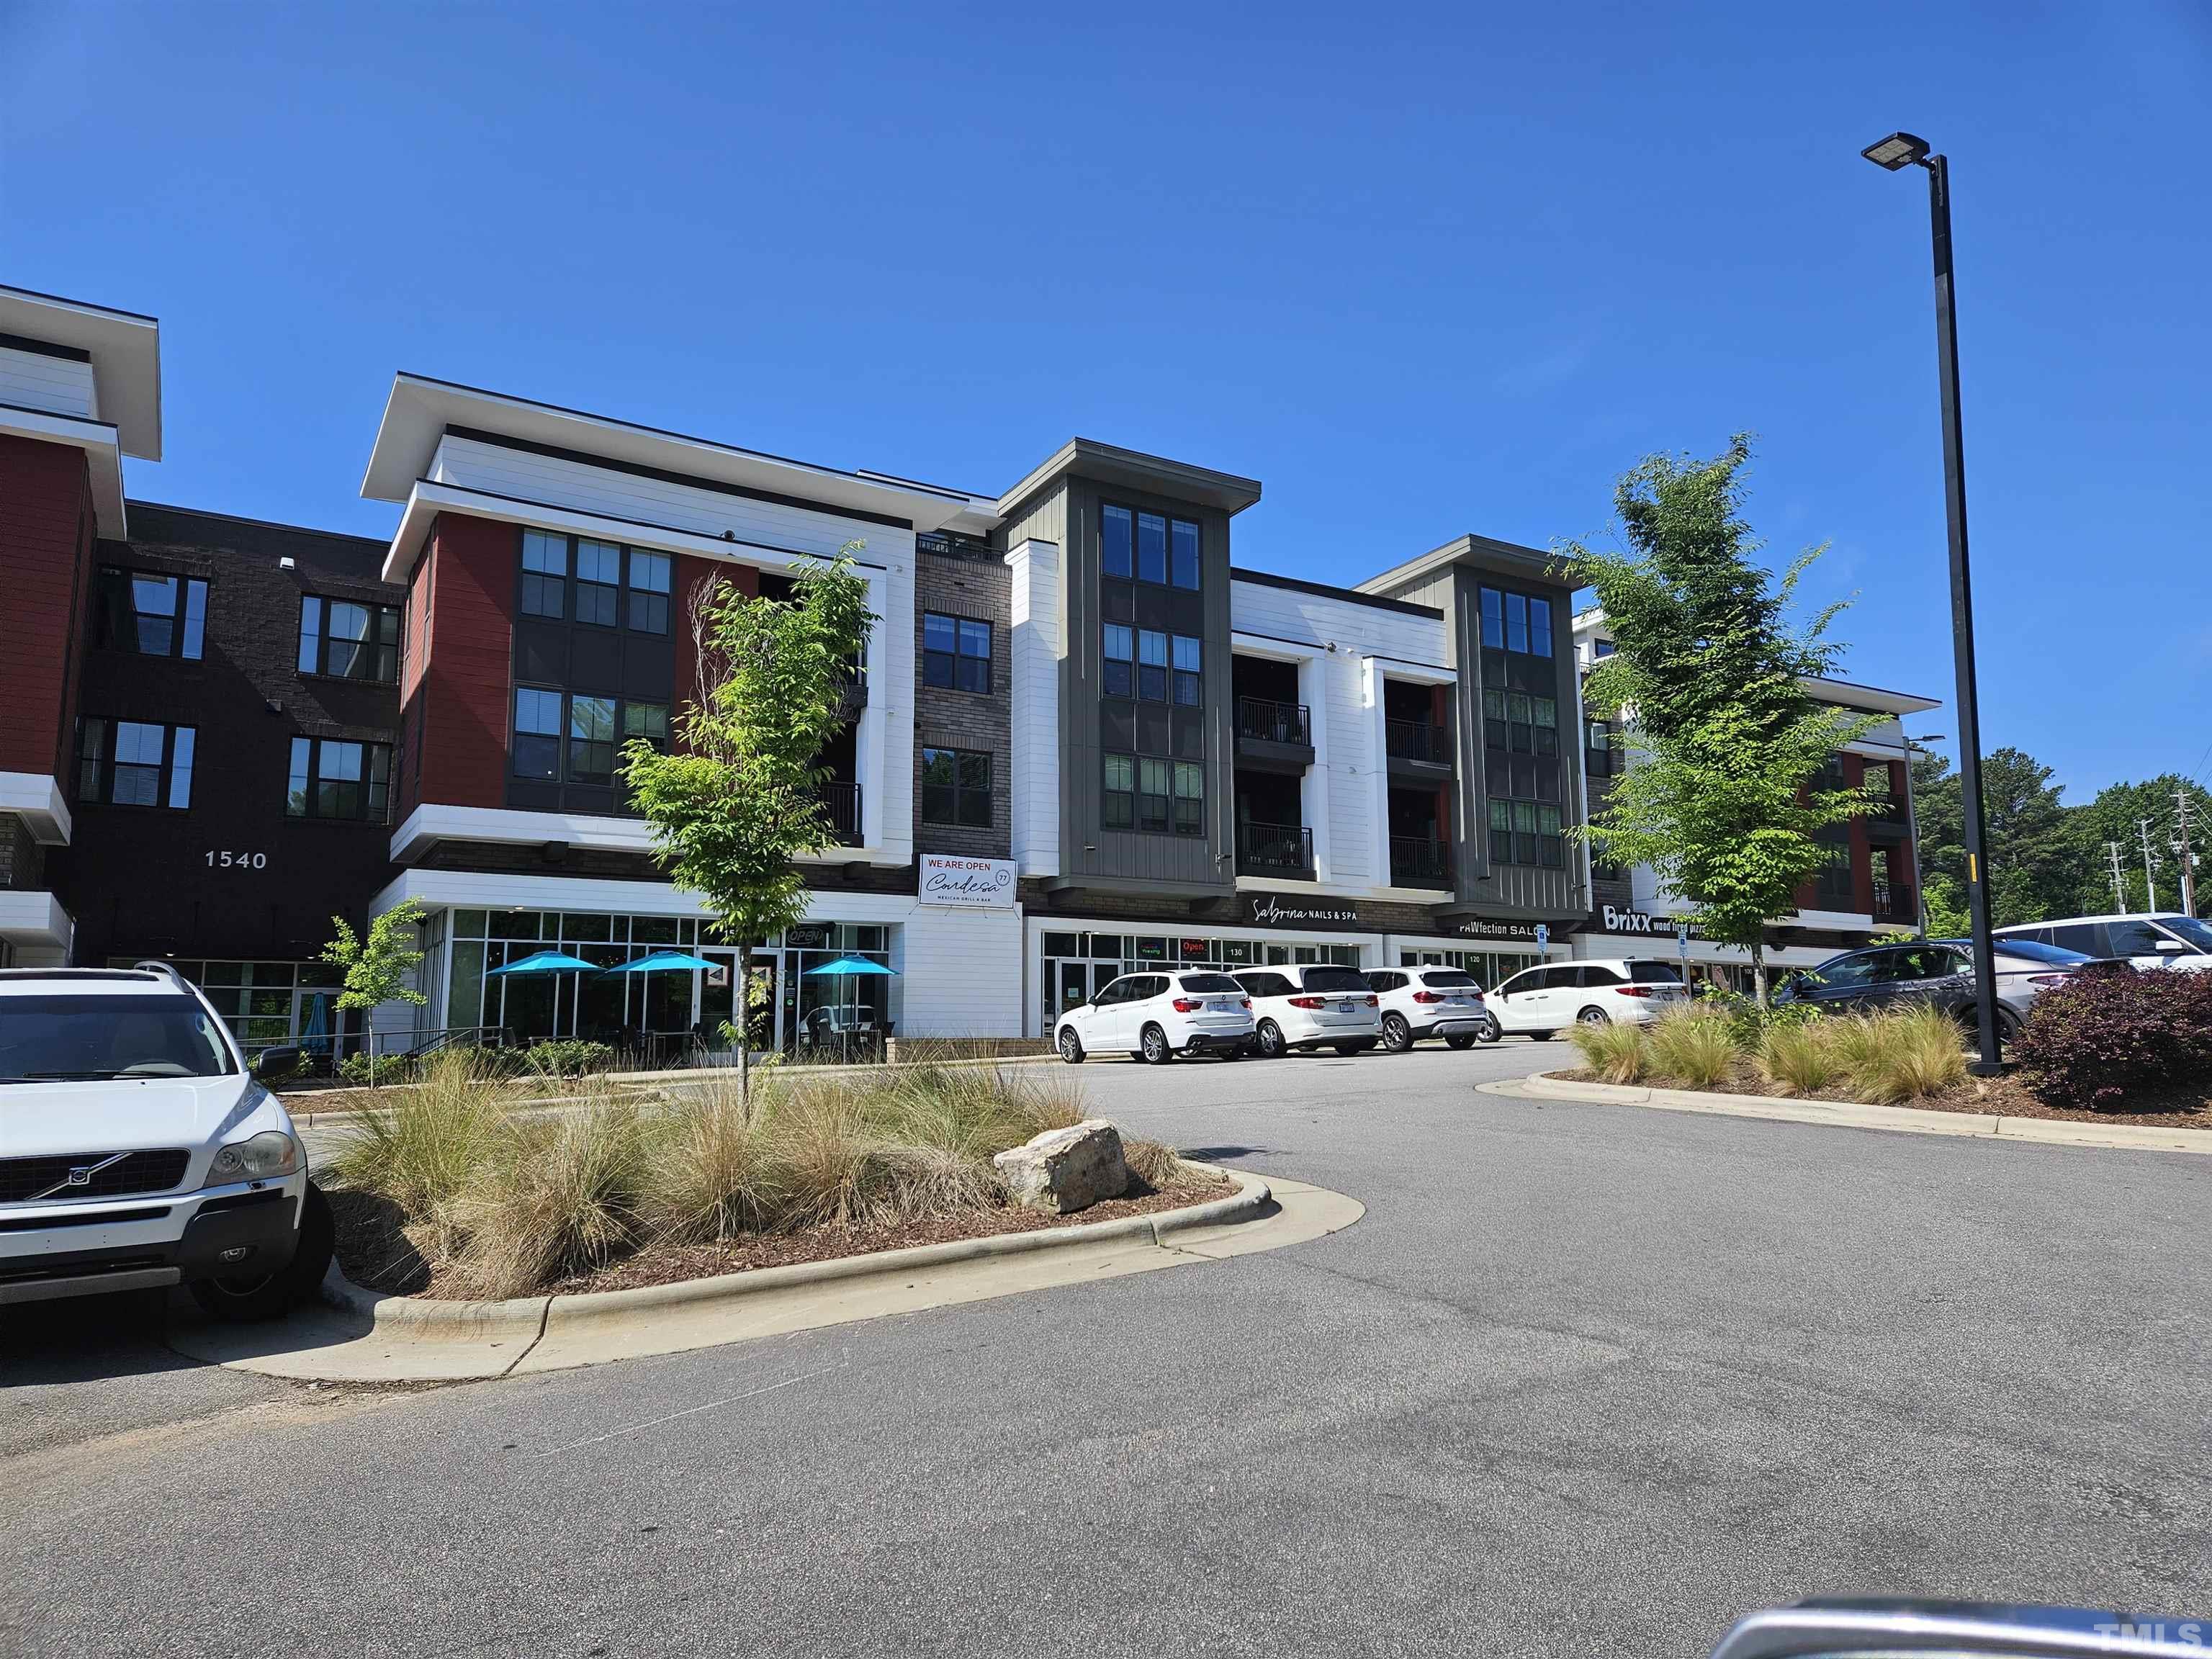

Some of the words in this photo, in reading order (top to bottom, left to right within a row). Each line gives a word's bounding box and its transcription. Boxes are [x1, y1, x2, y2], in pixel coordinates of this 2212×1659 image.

[205, 850, 266, 869] 1540
[928, 859, 943, 868] WE
[945, 860, 963, 869] ARE
[966, 862, 991, 871] OPEN
[926, 873, 1001, 894] Condesa
[1253, 896, 1308, 923] Sabrina
[1308, 910, 1332, 920] NAILS
[1334, 911, 1340, 920] &
[1341, 912, 1357, 921] SPA
[1603, 904, 1652, 932] Brixx
[1653, 922, 1671, 931] wood
[1672, 922, 1689, 932] fired
[790, 930, 819, 942] OPEN
[1183, 942, 1205, 951] Open
